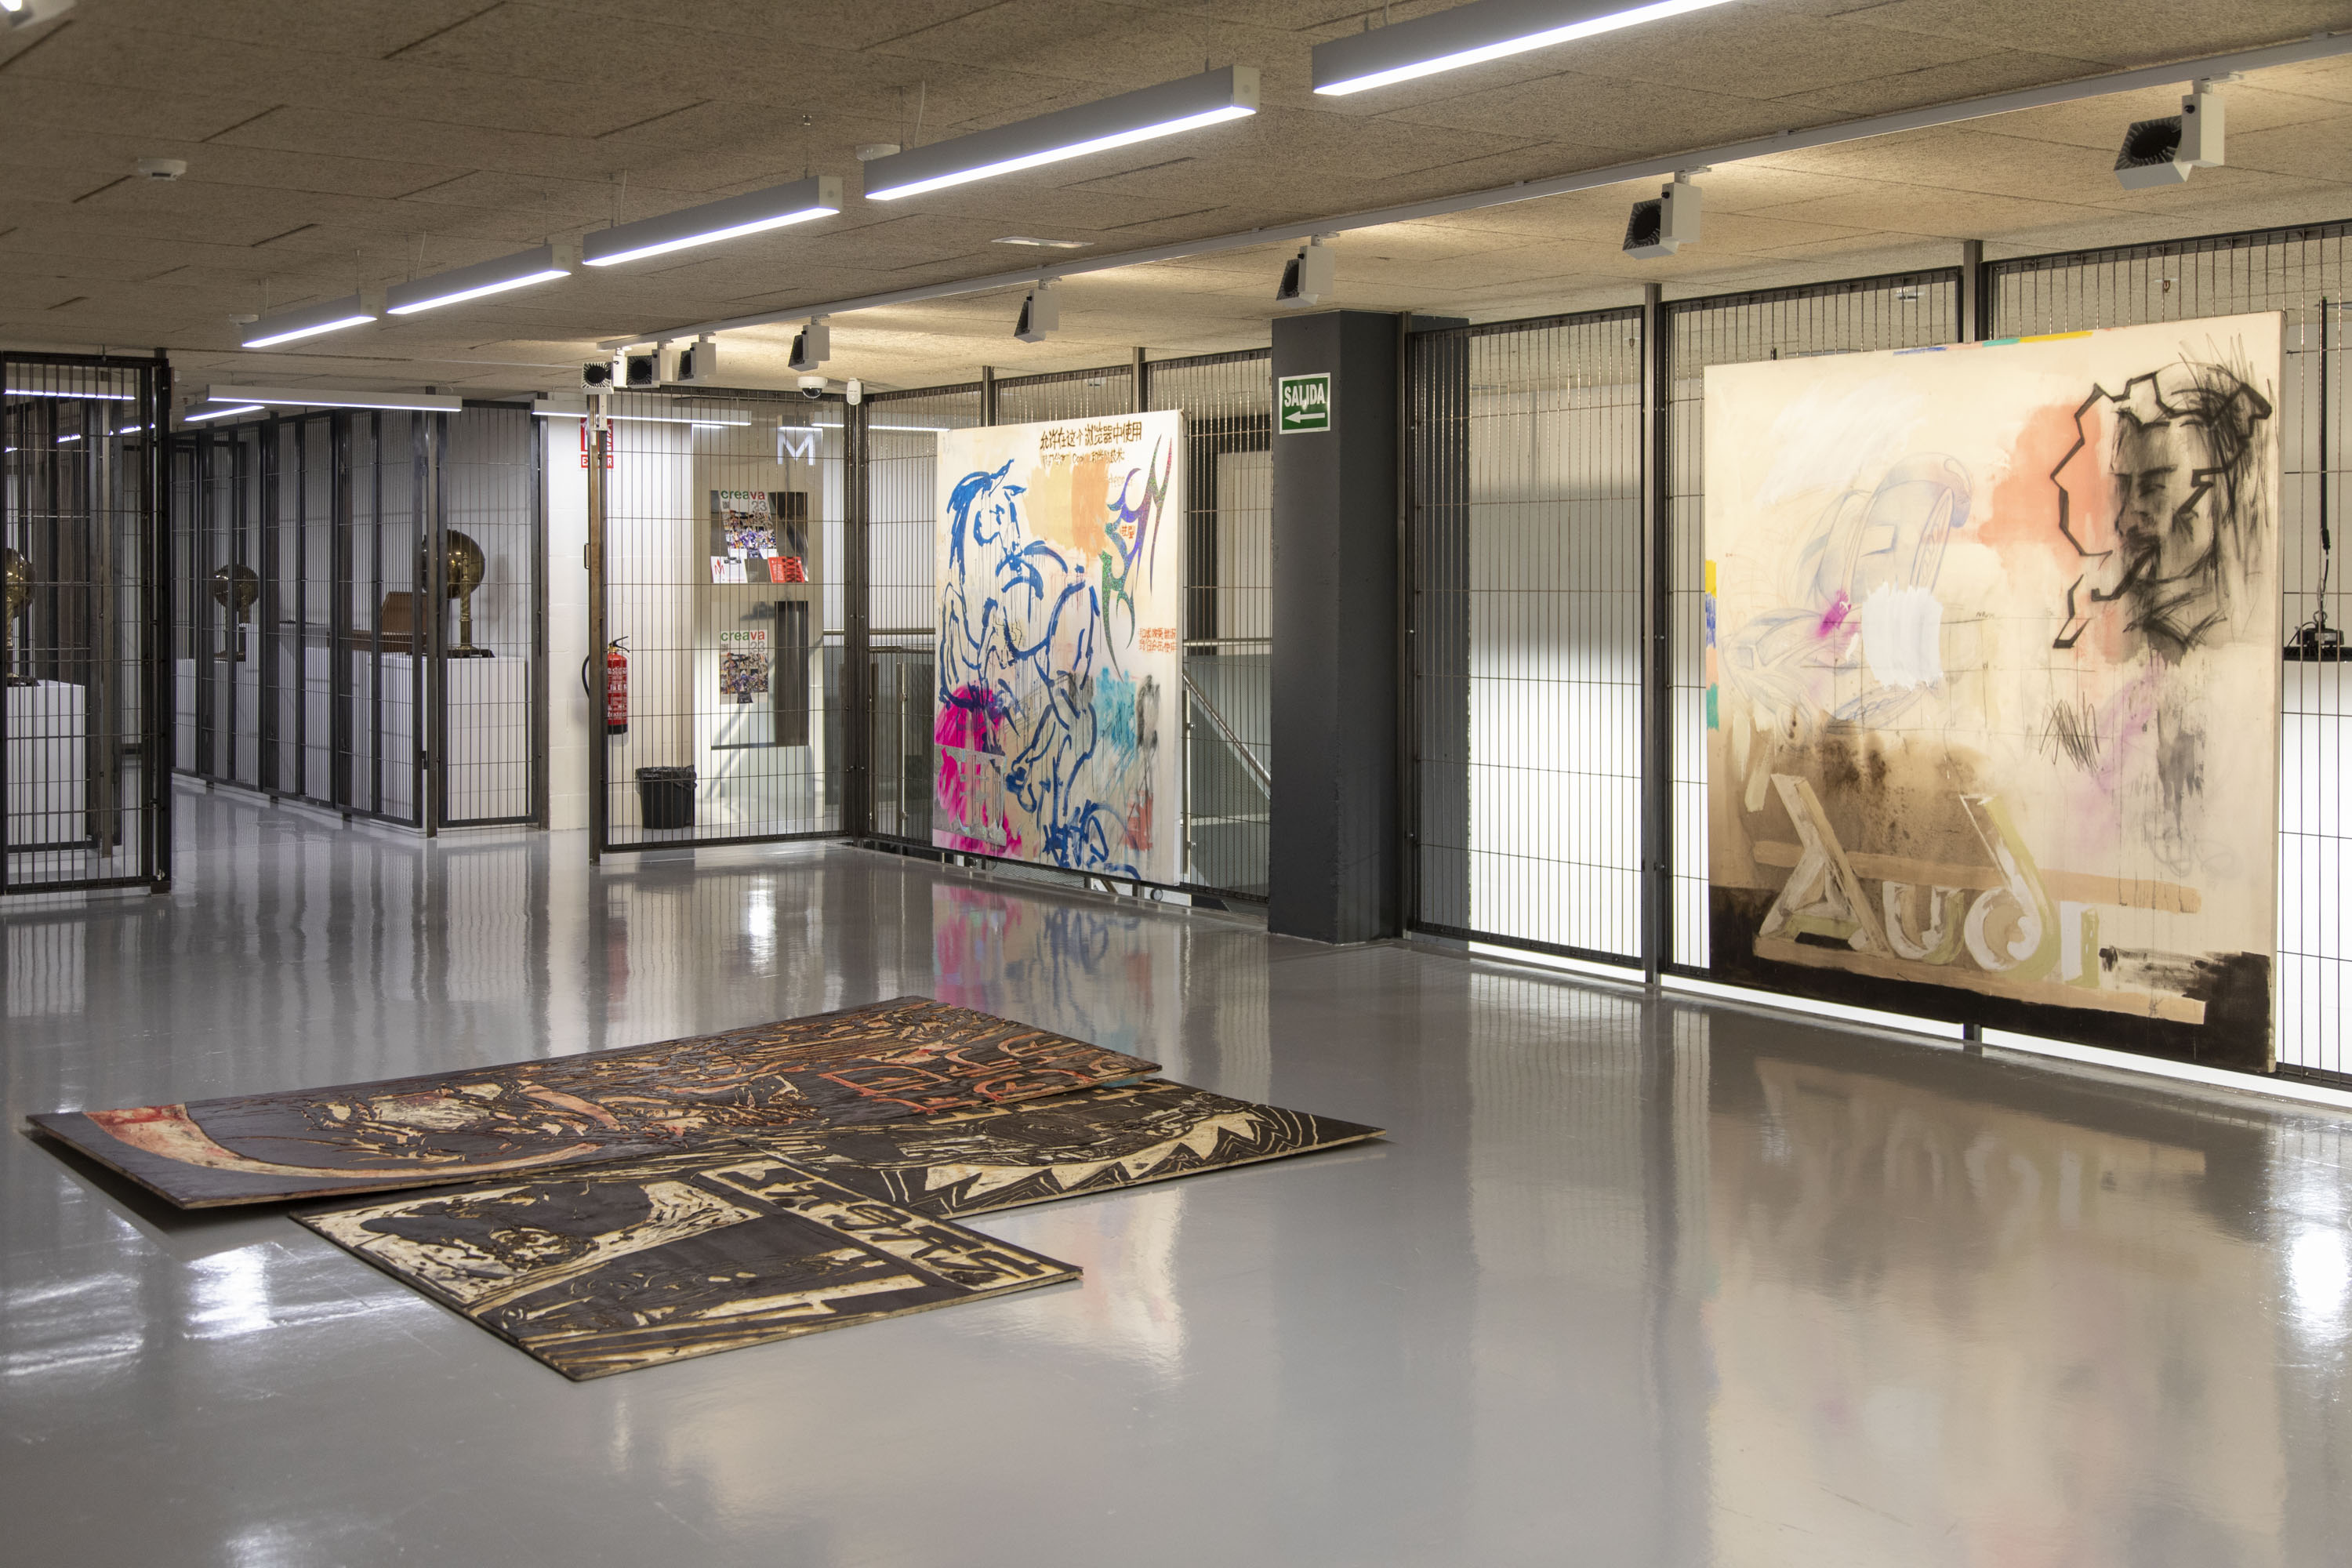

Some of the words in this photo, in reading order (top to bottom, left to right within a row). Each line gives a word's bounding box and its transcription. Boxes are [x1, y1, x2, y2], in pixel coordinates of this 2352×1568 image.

[1284, 383, 1327, 407] SALIDA
[1040, 419, 1142, 451] 允许在这个浏览器中使用
[777, 431, 815, 466] M
[720, 490, 766, 500] creava
[751, 500, 768, 512] 23
[720, 630, 765, 641] creava
[750, 641, 765, 653] 23
